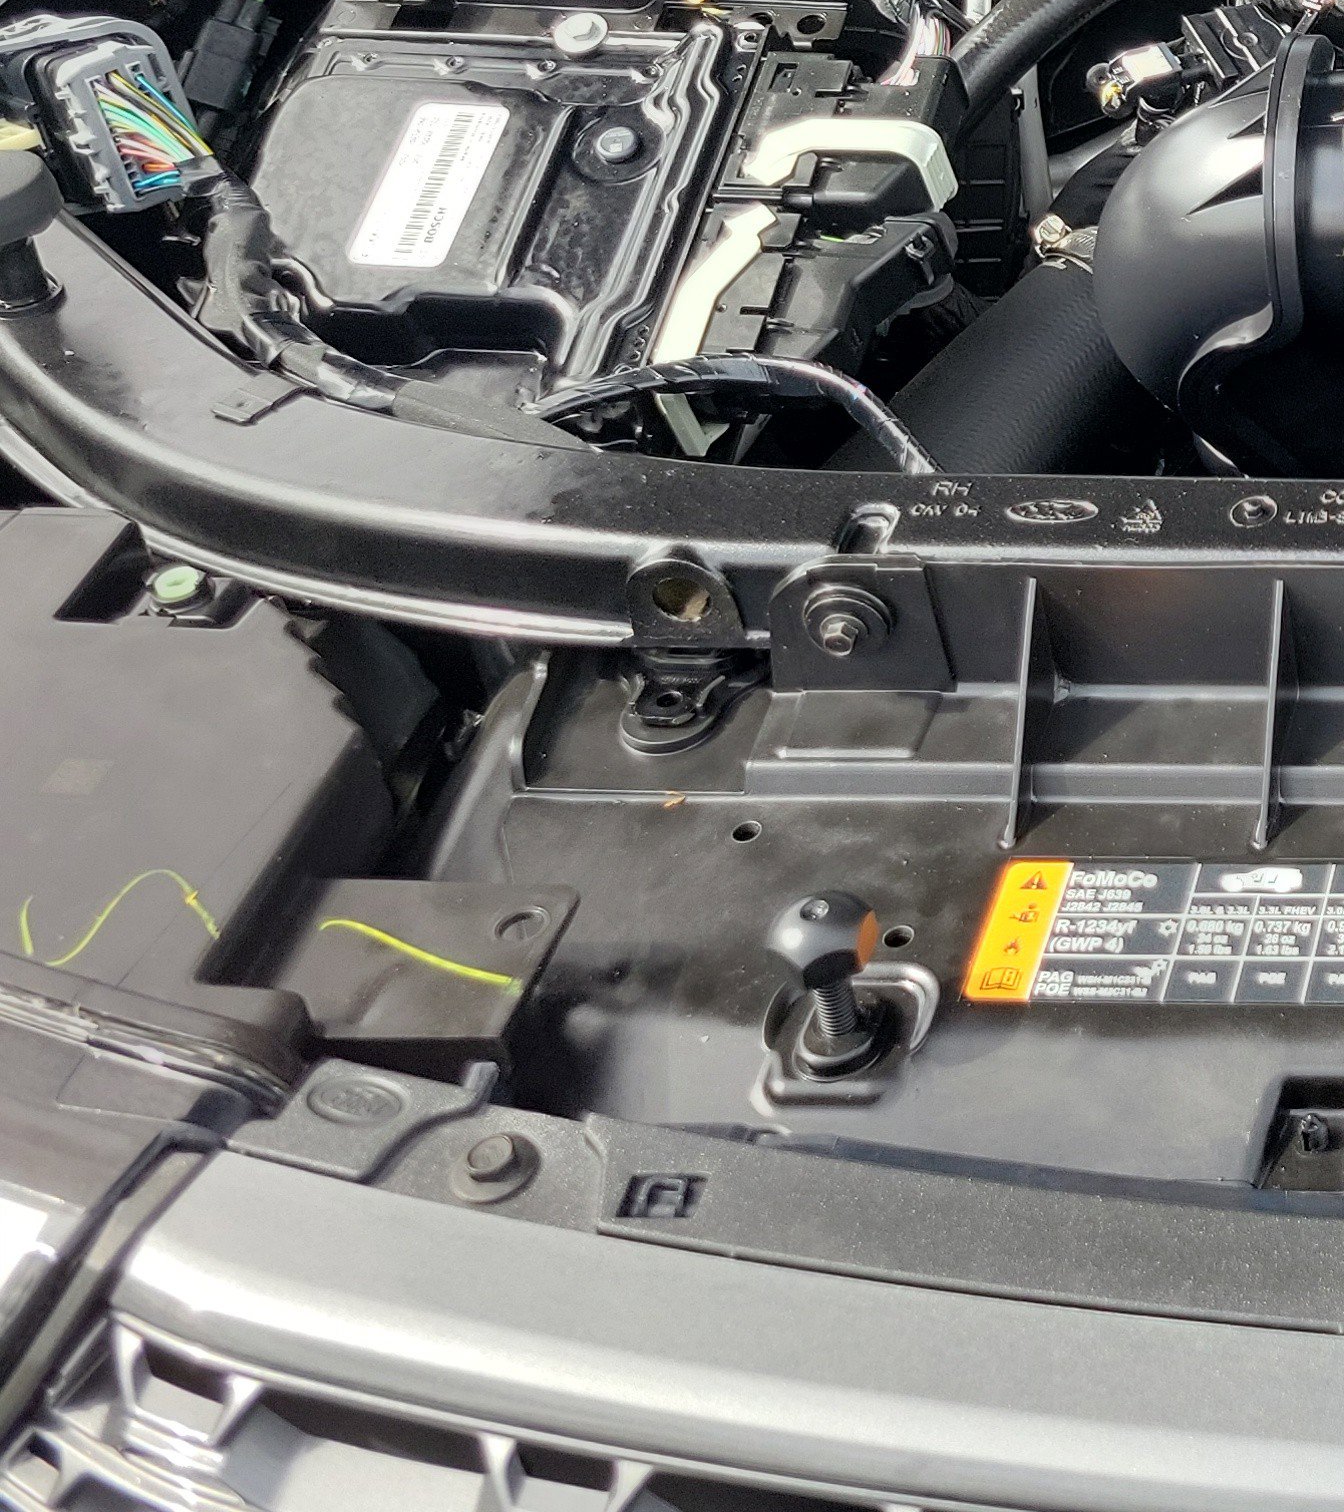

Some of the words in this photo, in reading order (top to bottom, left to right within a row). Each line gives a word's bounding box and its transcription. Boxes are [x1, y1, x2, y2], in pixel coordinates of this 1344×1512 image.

[424, 207, 447, 243] BOSCH
[931, 481, 972, 497] RH
[1069, 870, 1158, 888] FoMoCo
[1065, 889, 1097, 900] SAE
[1055, 919, 1138, 935] R-1234yf
[1225, 920, 1244, 935] kg
[1254, 920, 1291, 933] 0.737
[1292, 921, 1312, 936] kg
[1049, 937, 1103, 953] (GWP
[1103, 937, 1124, 953] 4)
[1280, 935, 1296, 945] oz
[1038, 970, 1074, 983] PAG
[1034, 982, 1072, 995] POE
